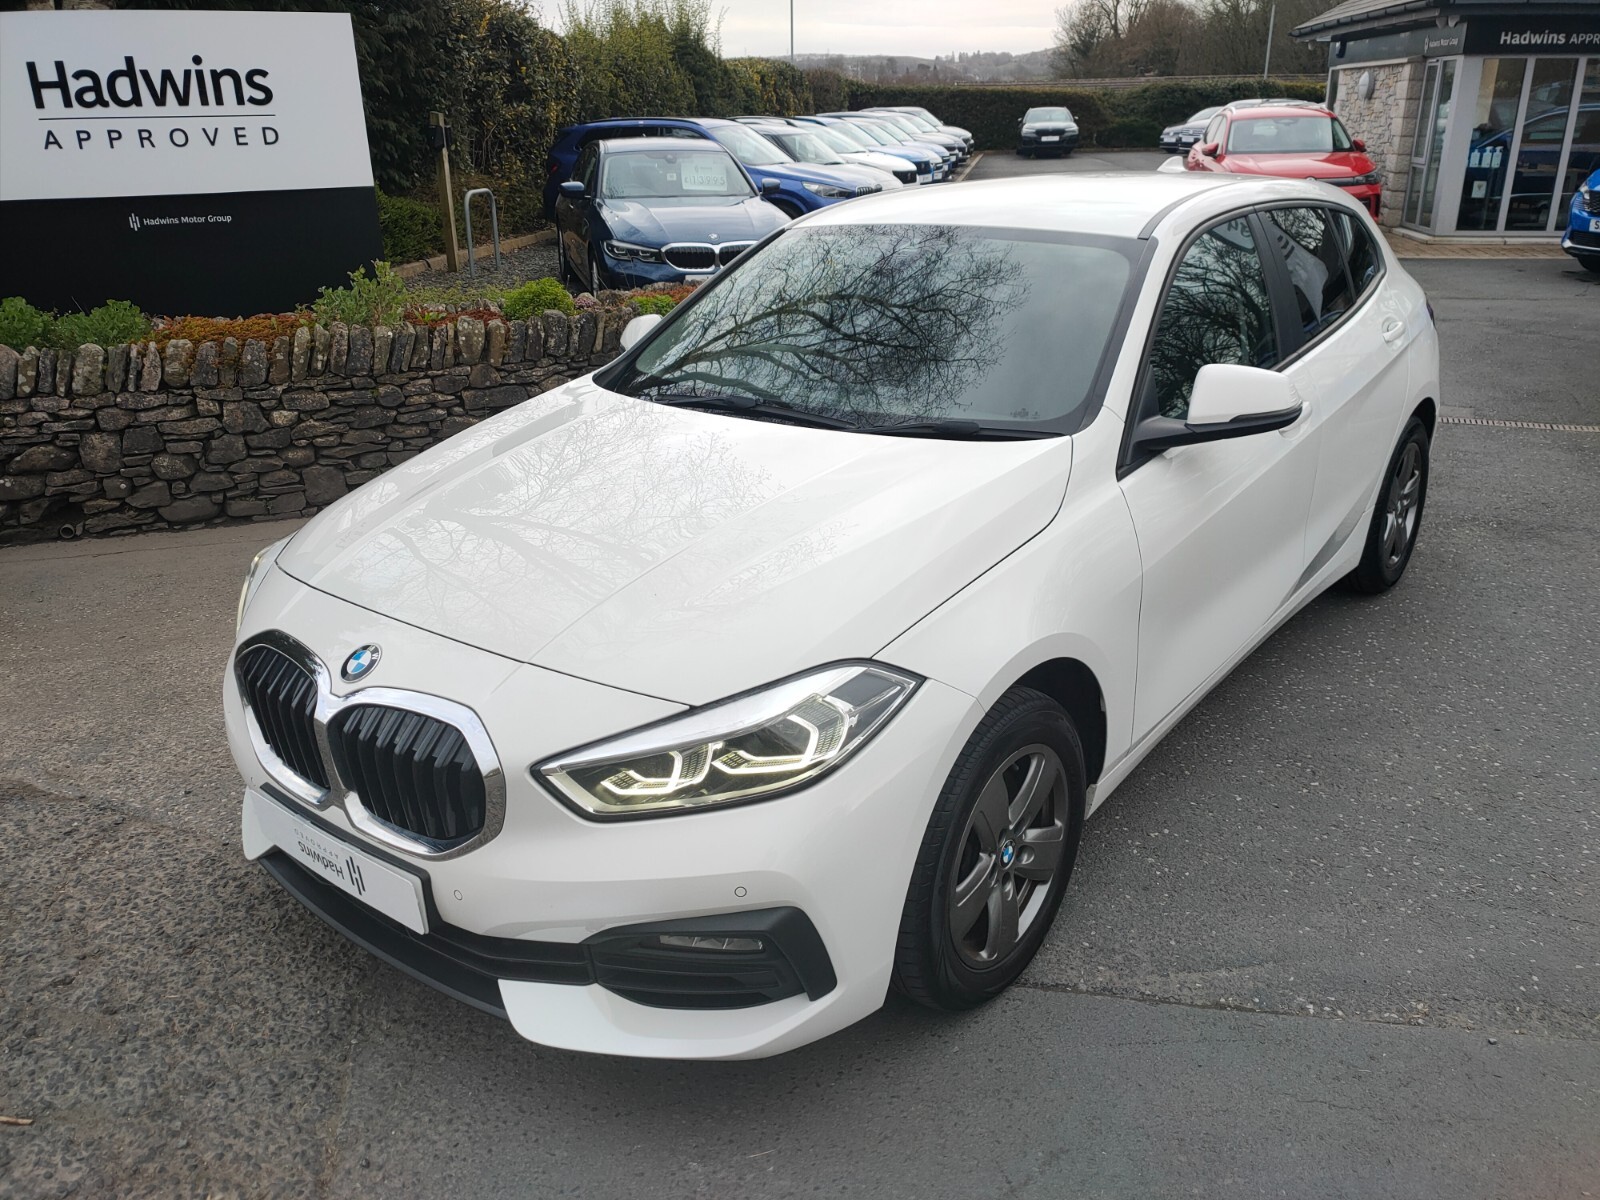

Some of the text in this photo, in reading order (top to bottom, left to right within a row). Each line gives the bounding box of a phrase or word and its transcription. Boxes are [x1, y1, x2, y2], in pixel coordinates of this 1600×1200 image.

[1500, 30, 1600, 45] Hadwins APPR
[26, 54, 274, 110] Hadwins
[44, 126, 280, 150] APPROVED
[143, 214, 233, 226] Hadwins Motor Group
[298, 841, 345, 880] Hadwins
